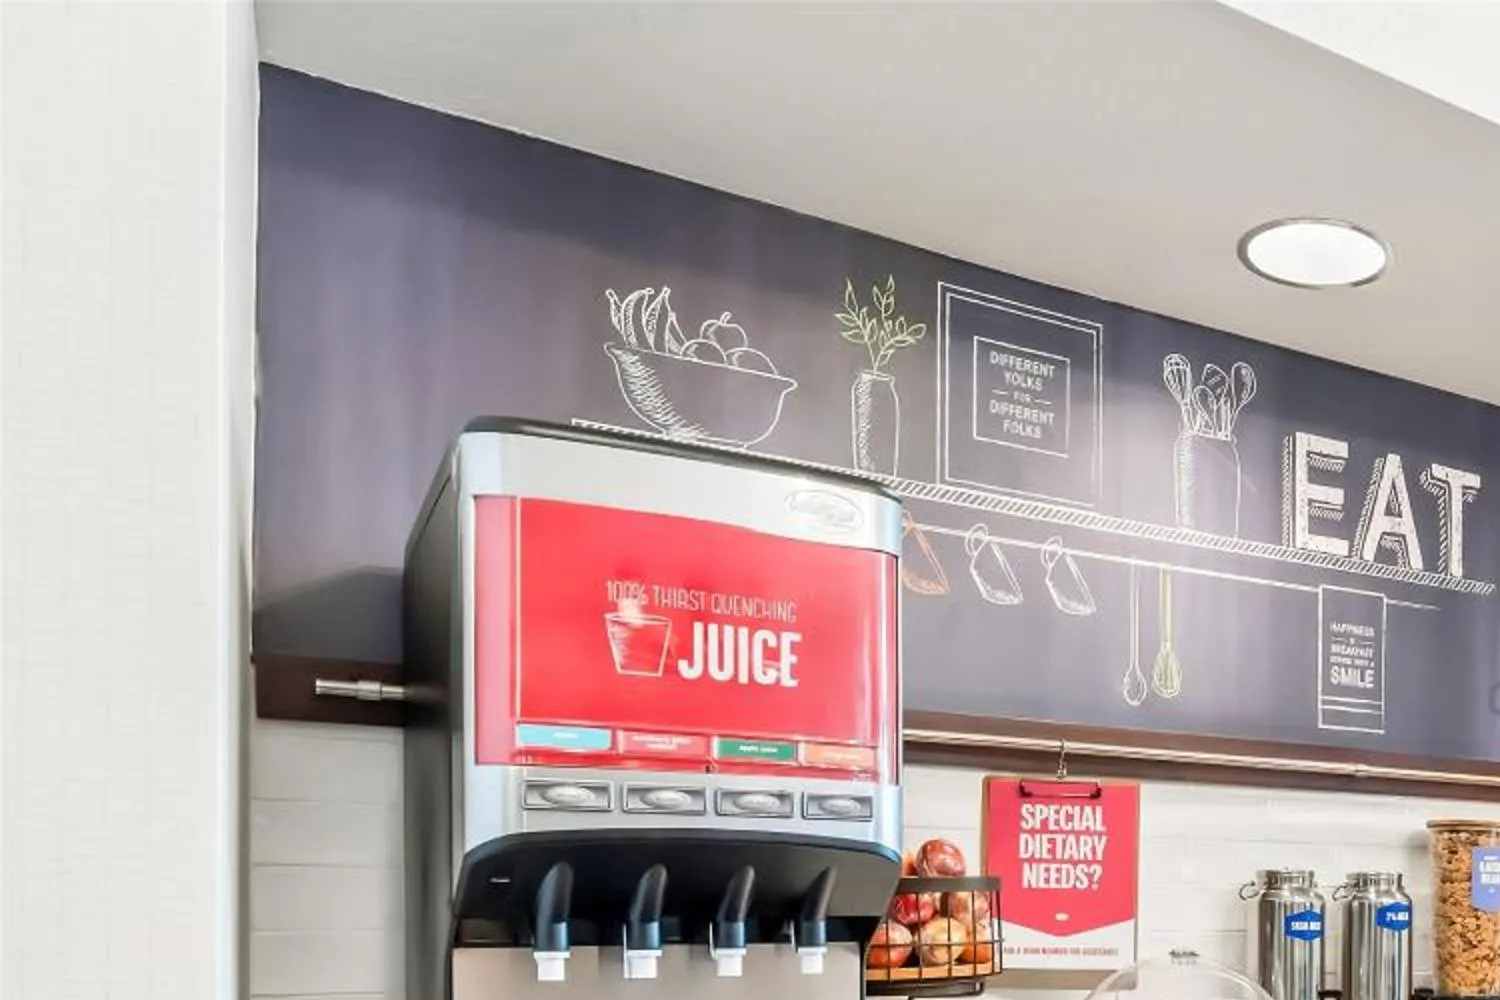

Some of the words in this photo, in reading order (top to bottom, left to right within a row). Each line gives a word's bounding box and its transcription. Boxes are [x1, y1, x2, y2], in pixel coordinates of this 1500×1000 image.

[989, 350, 1055, 378] DIFFERENT
[1003, 371, 1043, 391] YOLKS
[989, 399, 1055, 425] DIFFERENT
[1003, 419, 1041, 439] FOLKS
[1282, 431, 1481, 577] EAT
[652, 585, 708, 611] THIRST
[711, 593, 798, 623] QUENCHING
[677, 621, 802, 687] JUICE
[1330, 665, 1375, 688] SMILE
[1020, 804, 1106, 832] SPECIAL
[1019, 833, 1107, 861] DIETARY
[1022, 862, 1103, 890] NEEDS?
